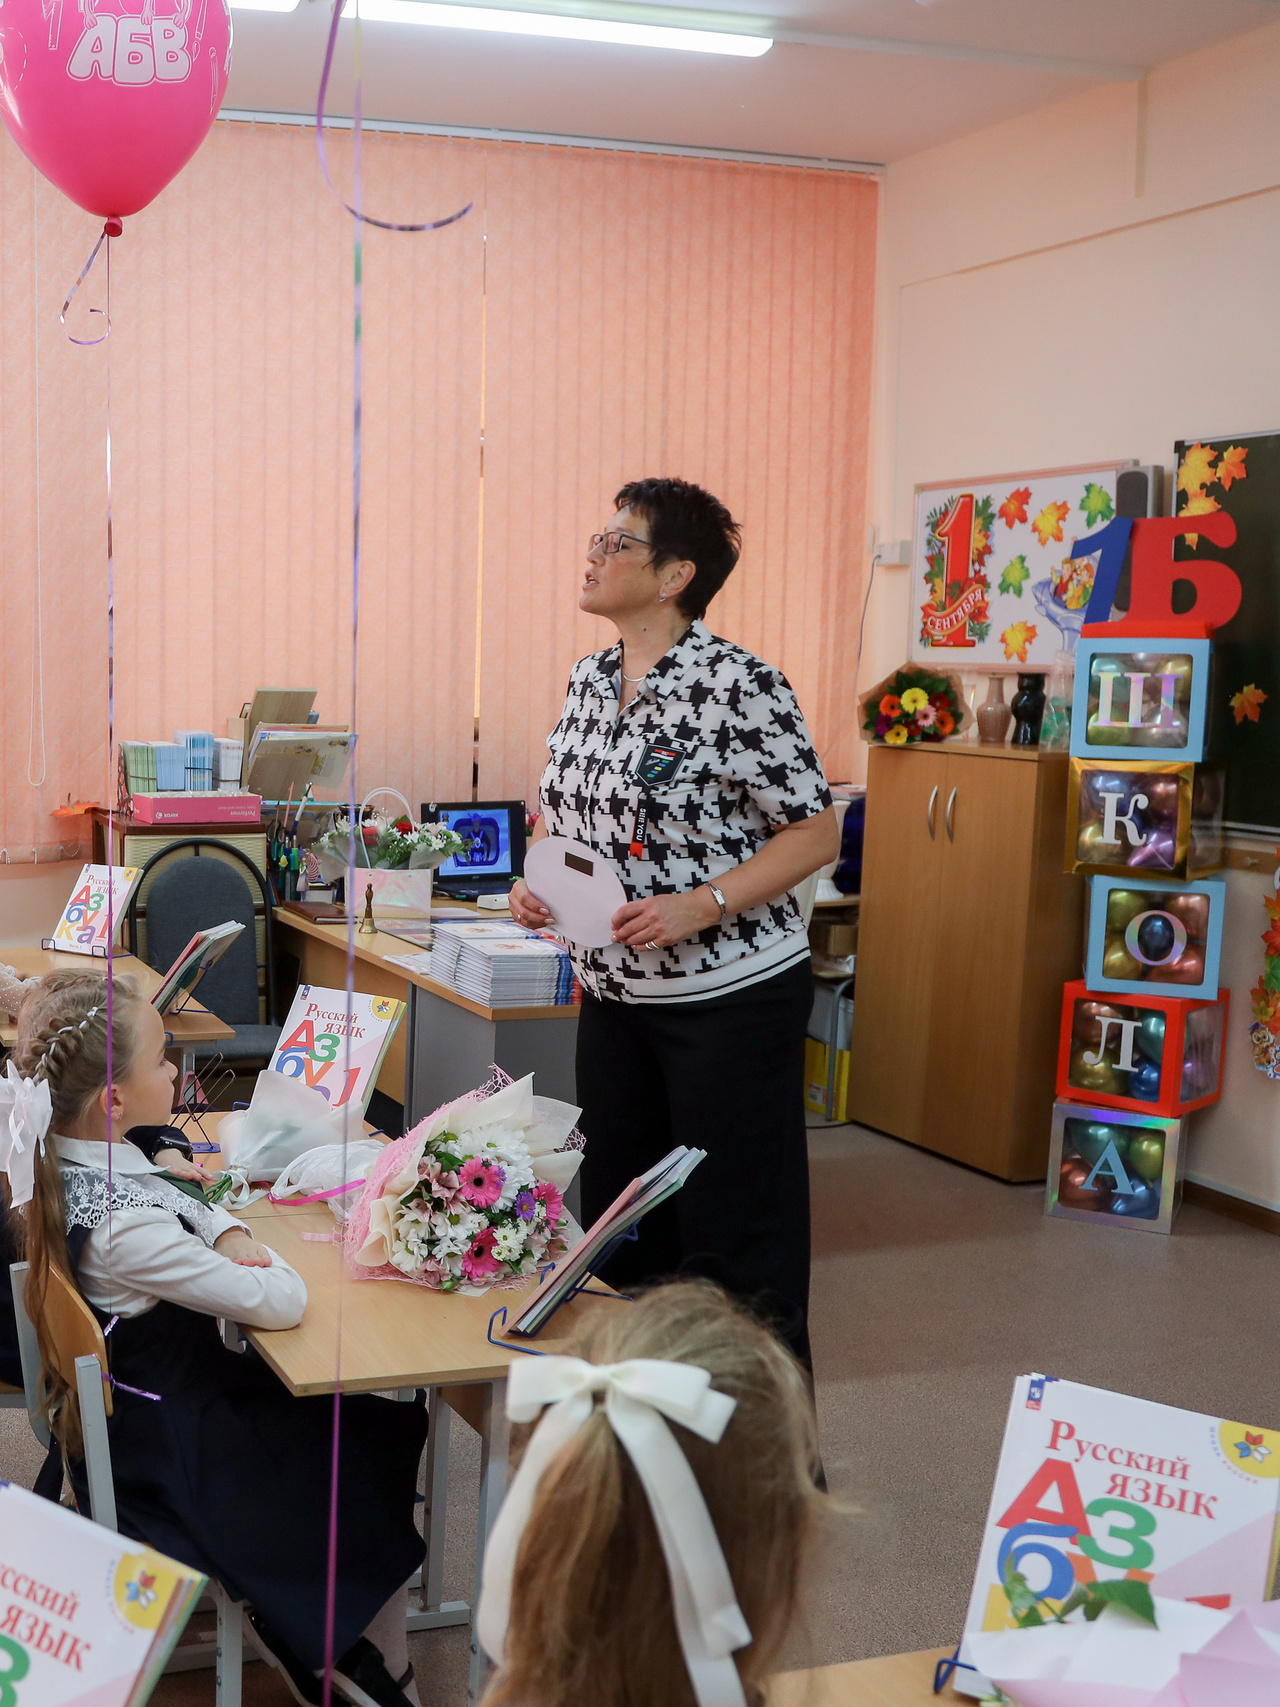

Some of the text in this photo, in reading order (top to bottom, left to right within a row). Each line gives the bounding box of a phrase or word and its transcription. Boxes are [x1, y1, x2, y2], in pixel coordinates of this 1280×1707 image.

[66, 13, 192, 87] АБВ
[930, 493, 978, 648] 1
[927, 588, 982, 630] СЕНТЯБРЯ
[636, 824, 646, 841] YOU
[305, 1002, 359, 1024] Русский
[1045, 1418, 1191, 1482] Русский
